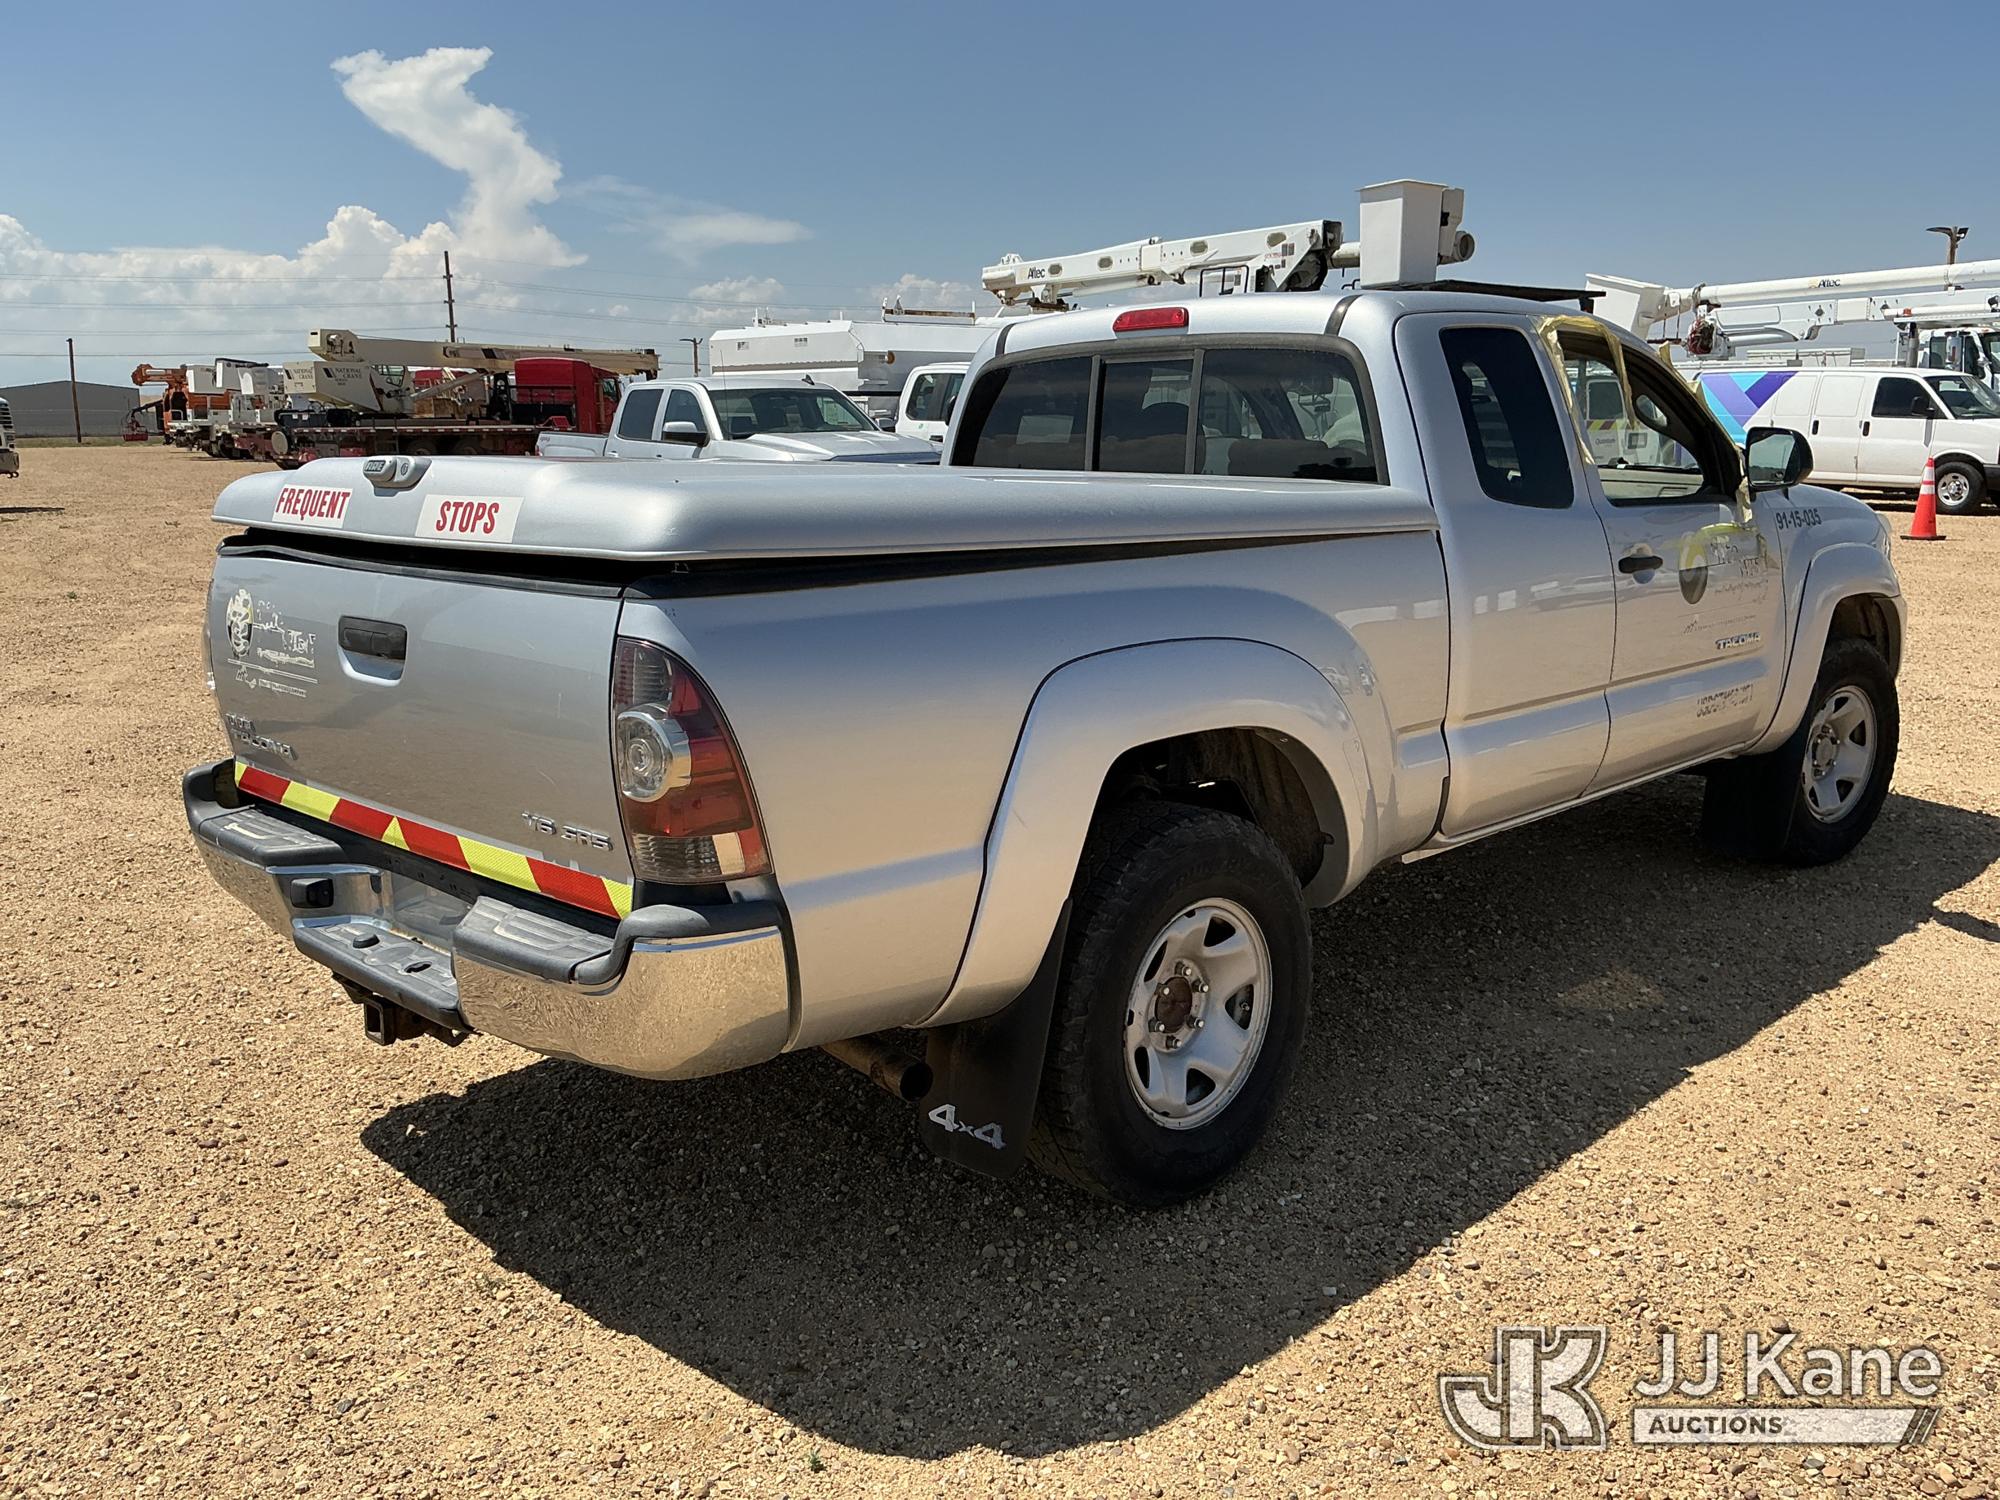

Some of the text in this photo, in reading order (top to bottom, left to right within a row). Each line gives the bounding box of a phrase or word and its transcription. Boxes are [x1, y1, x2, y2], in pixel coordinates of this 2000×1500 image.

[1028, 266, 1046, 279] Altec
[1818, 278, 1841, 288] Altec
[275, 487, 351, 520] FREQUENT
[435, 500, 499, 534] STOPS
[1775, 508, 1822, 530] 91-15-035
[1715, 632, 1761, 650] TACOMA
[560, 824, 615, 852] SR5
